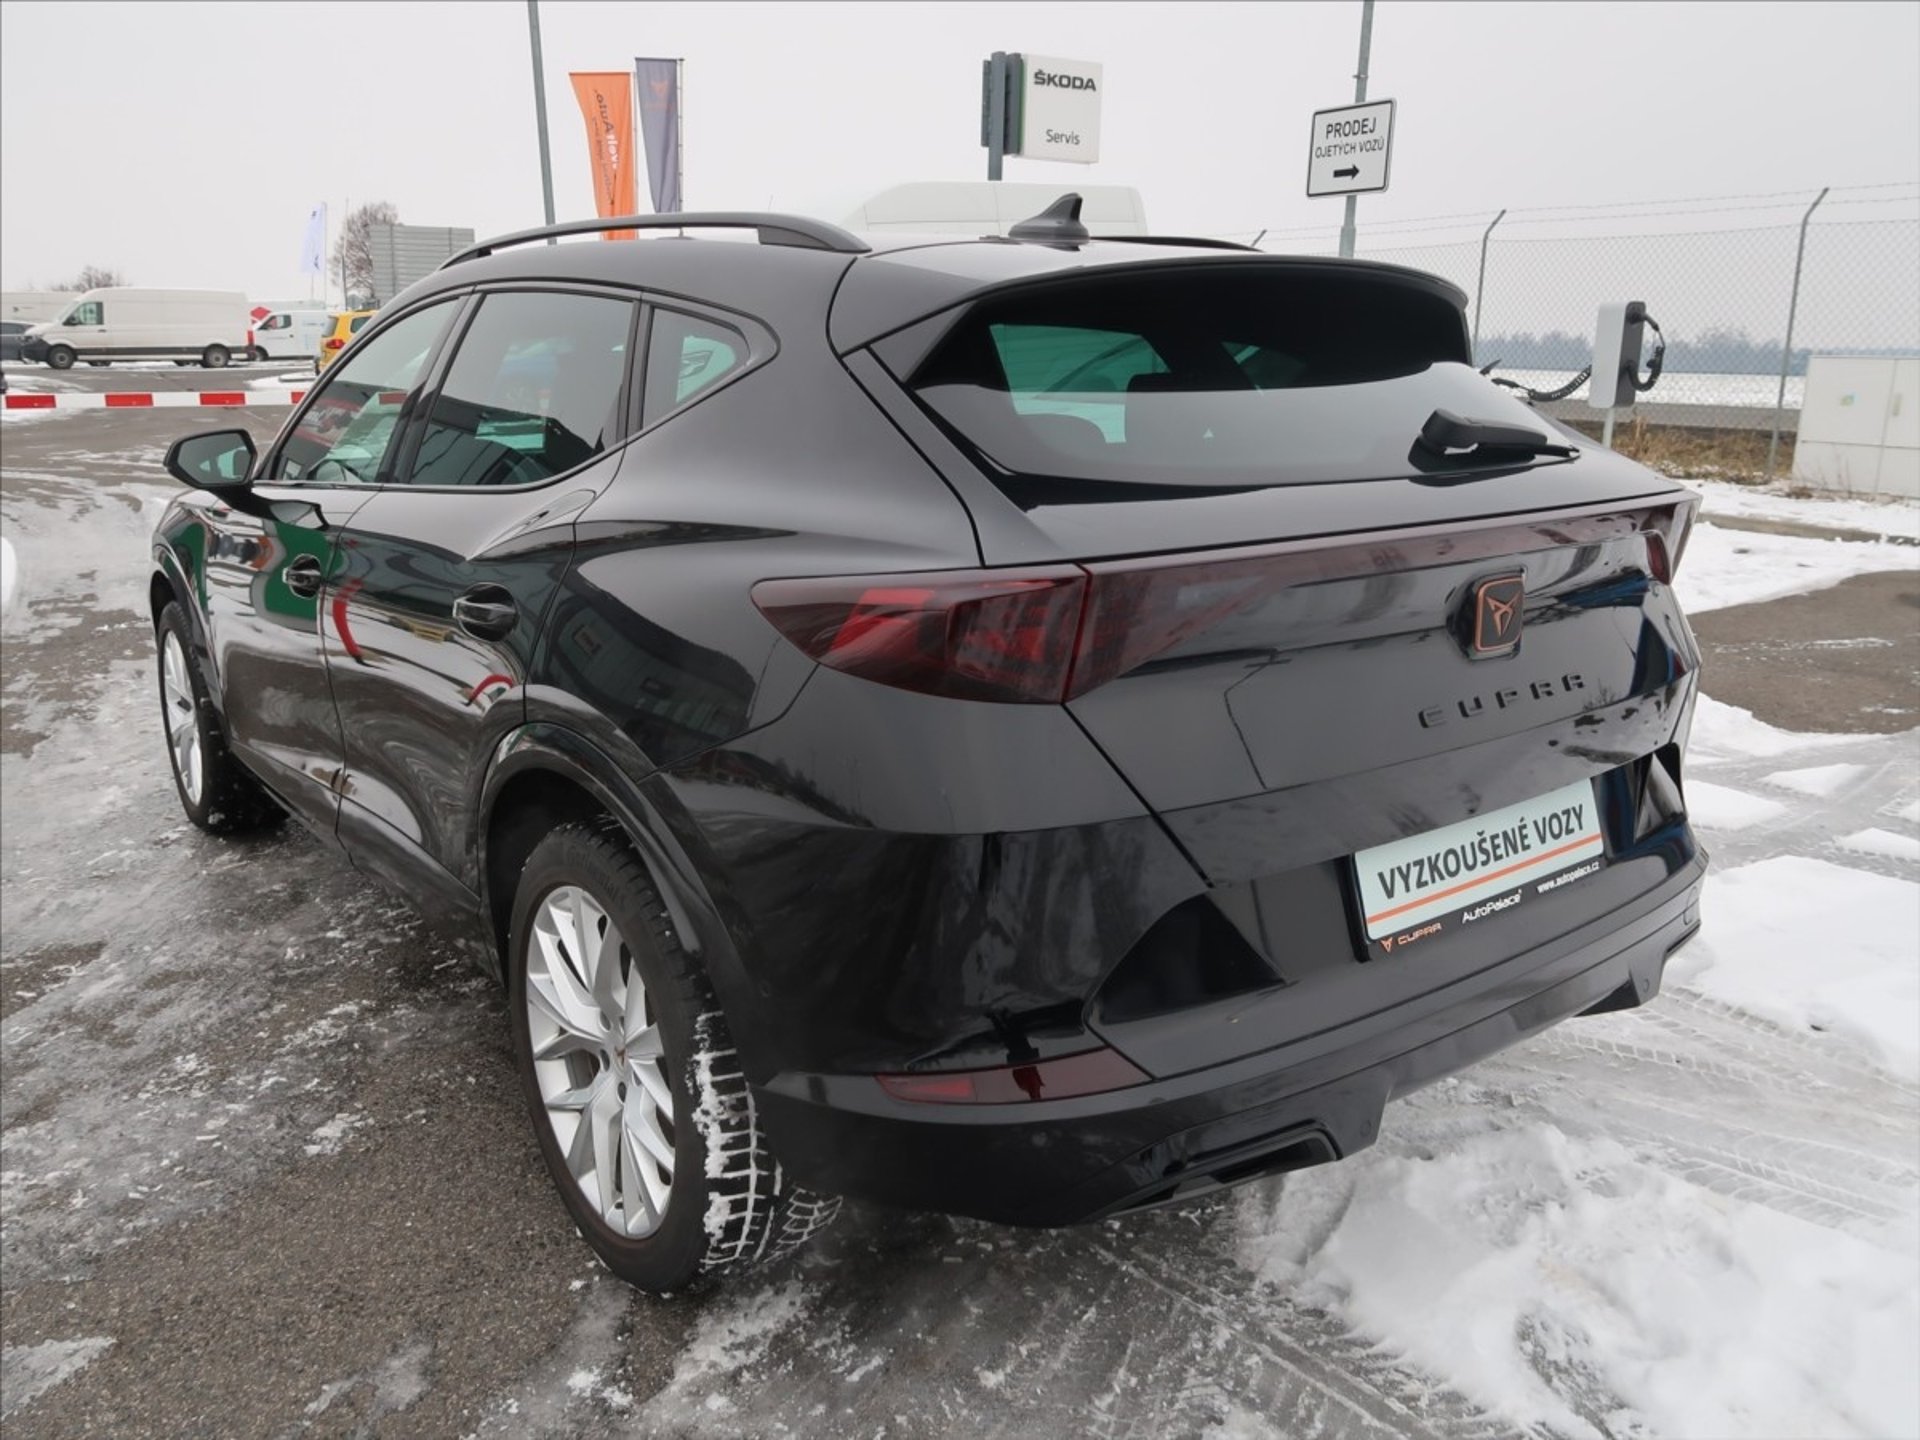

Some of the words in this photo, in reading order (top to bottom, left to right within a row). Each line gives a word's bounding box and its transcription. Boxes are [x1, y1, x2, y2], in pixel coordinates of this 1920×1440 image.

[1034, 69, 1097, 92] ŠKODA
[1046, 129, 1081, 145] Servis
[1326, 117, 1377, 139] PRODEJ
[1315, 141, 1356, 159] OJETÝCH
[1418, 674, 1585, 728] CUPRA
[1377, 816, 1531, 900] VYZKOUŠENÉ
[1533, 804, 1584, 845] VOZY
[1537, 860, 1601, 894] www.autopalace.cz
[1397, 922, 1443, 946] CUPRA
